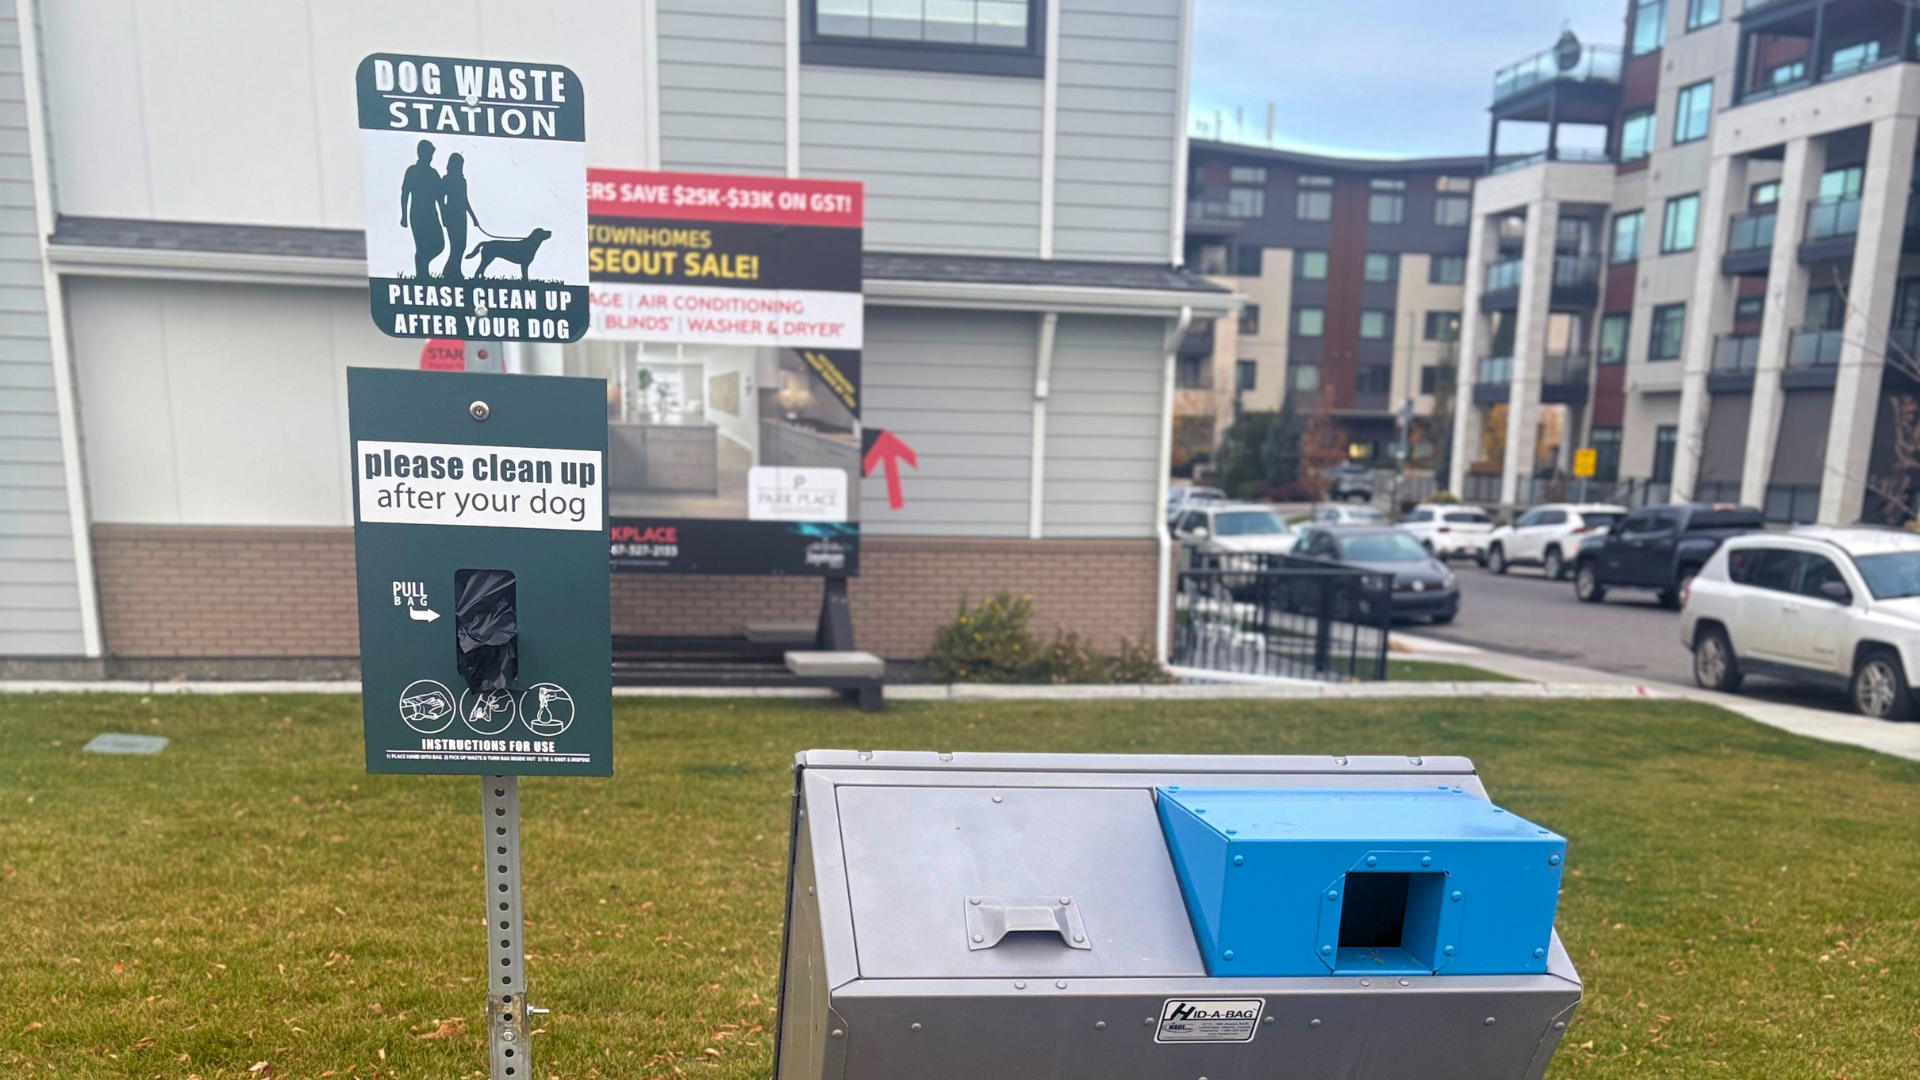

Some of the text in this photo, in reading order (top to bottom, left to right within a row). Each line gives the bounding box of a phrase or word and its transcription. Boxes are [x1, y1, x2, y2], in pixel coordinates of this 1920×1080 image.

[374, 59, 566, 103] DOG WASTE
[389, 101, 556, 137] STATION
[620, 183, 670, 204] SAVE
[672, 185, 775, 210] $25K-$33K
[778, 191, 807, 211] ON
[810, 193, 852, 214] GST!
[588, 224, 713, 249] TOWNHOMES
[589, 247, 759, 280] SEOUT SALE!
[388, 283, 572, 311] PLEASE CLEAN UP
[589, 292, 804, 315] AGE AIR CONDITIONING
[394, 313, 569, 339] AFTER YOUR DOG
[687, 317, 762, 334] WASHER
[767, 320, 778, 335] &
[365, 449, 595, 488] please clean up
[377, 482, 585, 522] after your dog
[610, 526, 678, 543] KPLACE
[393, 581, 428, 597] PULL
[394, 595, 428, 606] BAG
[421, 738, 555, 753] INSTRUCTIONS FOR USE
[1170, 1003, 1253, 1020] HID-A-BAG
